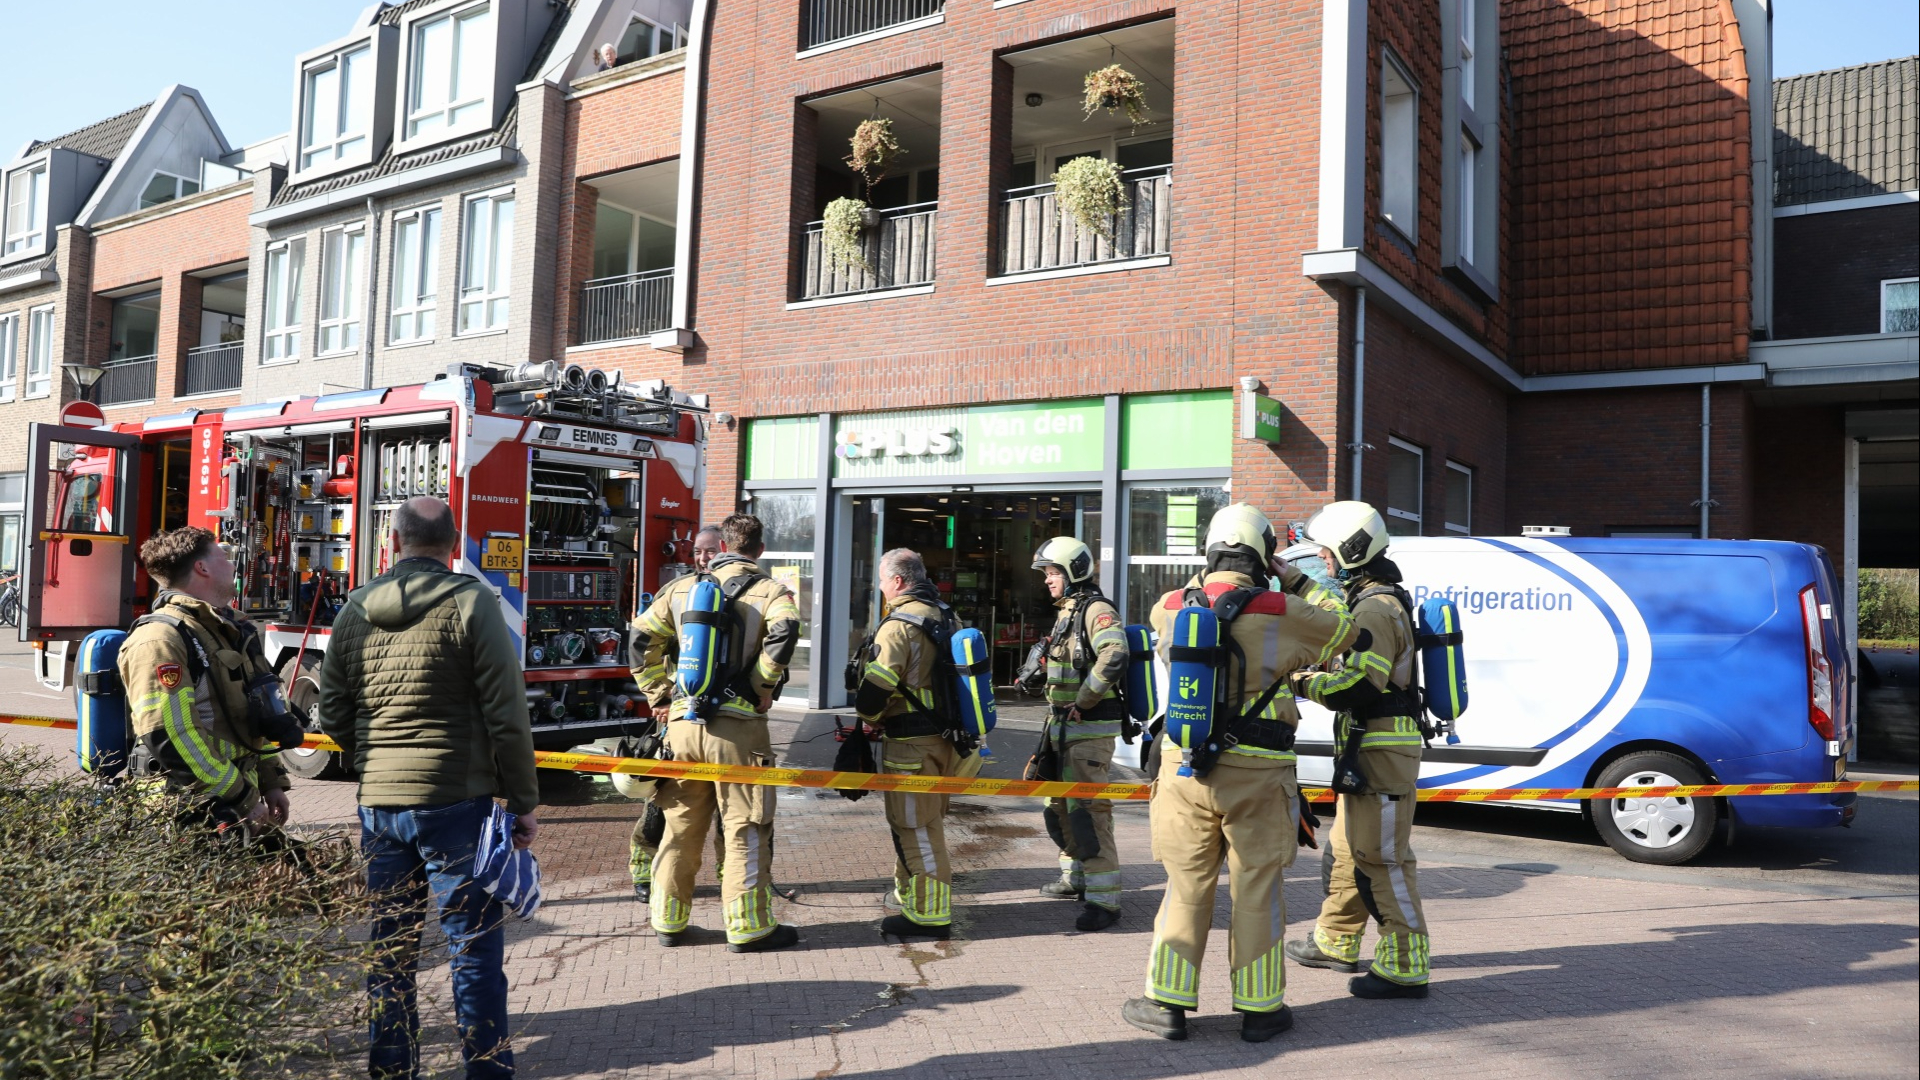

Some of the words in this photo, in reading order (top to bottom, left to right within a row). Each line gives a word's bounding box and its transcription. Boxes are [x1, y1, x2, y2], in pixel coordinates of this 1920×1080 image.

[979, 413, 1025, 437] Van
[1033, 410, 1084, 435] den
[1261, 412, 1279, 427] PLUS
[573, 429, 618, 446] EEMNES
[861, 426, 956, 457] PLUS
[200, 428, 211, 495] 09-1631
[978, 443, 1062, 466] Hoven
[471, 494, 519, 504] BRANDWEER
[497, 541, 512, 552] 06
[487, 555, 518, 567] BTR-5
[1169, 710, 1206, 720] Utrecht
